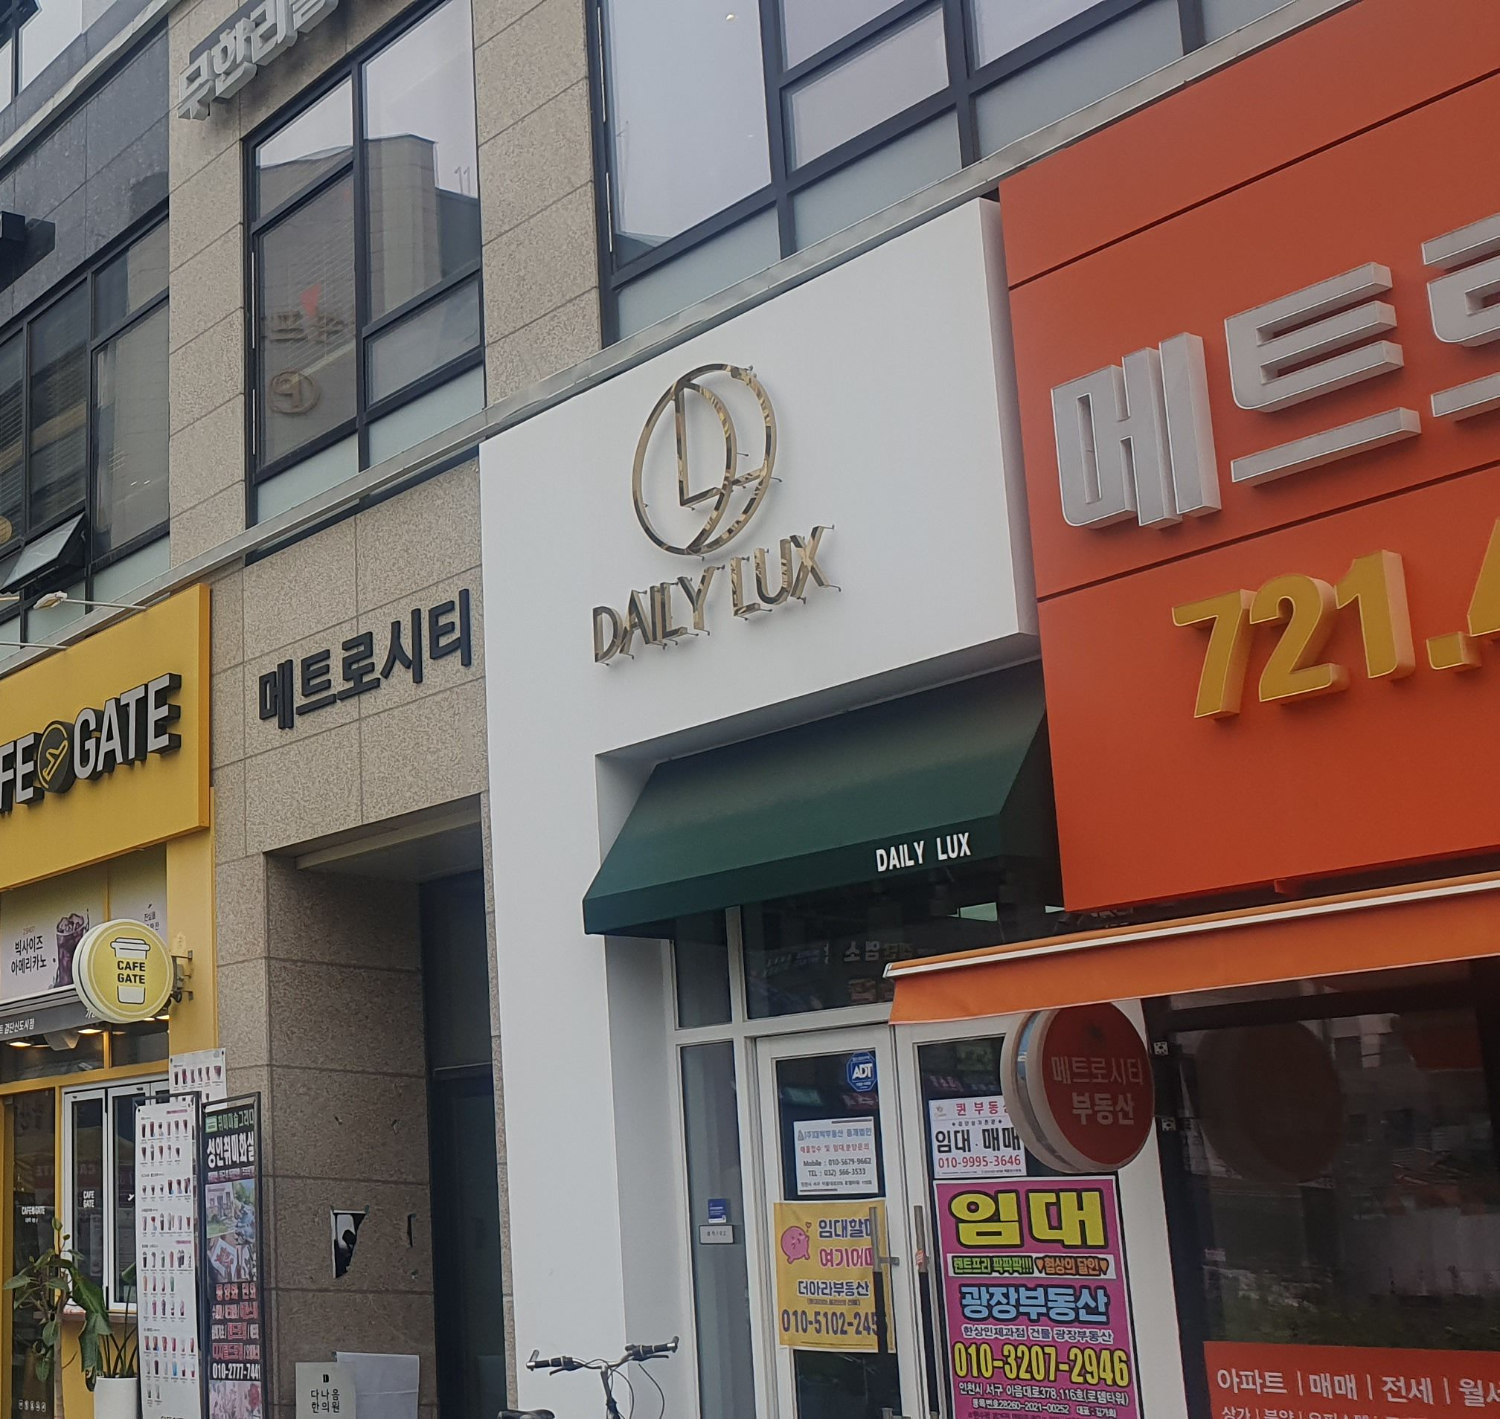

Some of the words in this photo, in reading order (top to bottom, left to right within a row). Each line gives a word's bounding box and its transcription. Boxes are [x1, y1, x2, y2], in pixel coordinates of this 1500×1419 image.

[592, 565, 722, 664] DAILY
[730, 524, 838, 619] LUX
[258, 588, 472, 730] 메트로시티
[73, 672, 182, 781] GATE
[875, 841, 925, 873] DAILY
[936, 831, 972, 862] LUX
[14, 934, 44, 957] 빅사이즈
[10, 953, 48, 977] 아메리카노
[117, 960, 146, 972] CAFE
[117, 973, 146, 985] GATE
[852, 1062, 873, 1080] ADT
[955, 1102, 967, 1117] 퀸
[1071, 1092, 1135, 1126] 부동산
[206, 1131, 255, 1169] 성인취미화실
[934, 1129, 972, 1154] 임대
[981, 1127, 1021, 1152] 매매
[803, 1159, 822, 1167] Mobile
[938, 1154, 1022, 1169] 010-9995-3646
[808, 1169, 818, 1177] TEL
[83, 1190, 95, 1200] CAFE
[83, 1199, 95, 1209] GATE
[950, 1190, 1107, 1248] 임대
[953, 1256, 991, 1274] 렌트프리
[1043, 1257, 1076, 1274] 협상의
[1077, 1258, 1100, 1275] 달인
[797, 1280, 870, 1297] 더아라부동산
[960, 1285, 1109, 1323] 광장부동산
[781, 1308, 878, 1336] 010-5102-245
[963, 1325, 1026, 1340] 한상민제과점
[1030, 1327, 1051, 1341] 건물
[1054, 1329, 1114, 1344] 광장부동산
[952, 1341, 1130, 1388] 010-3207-2946
[310, 1388, 340, 1401] 다나음
[958, 1383, 983, 1395] 인천시
[986, 1385, 1003, 1395] 서구
[1216, 1367, 1288, 1395] 아파트
[1308, 1372, 1359, 1401] 매매
[1381, 1375, 1435, 1406] 전세
[311, 1400, 340, 1414] 한의원
